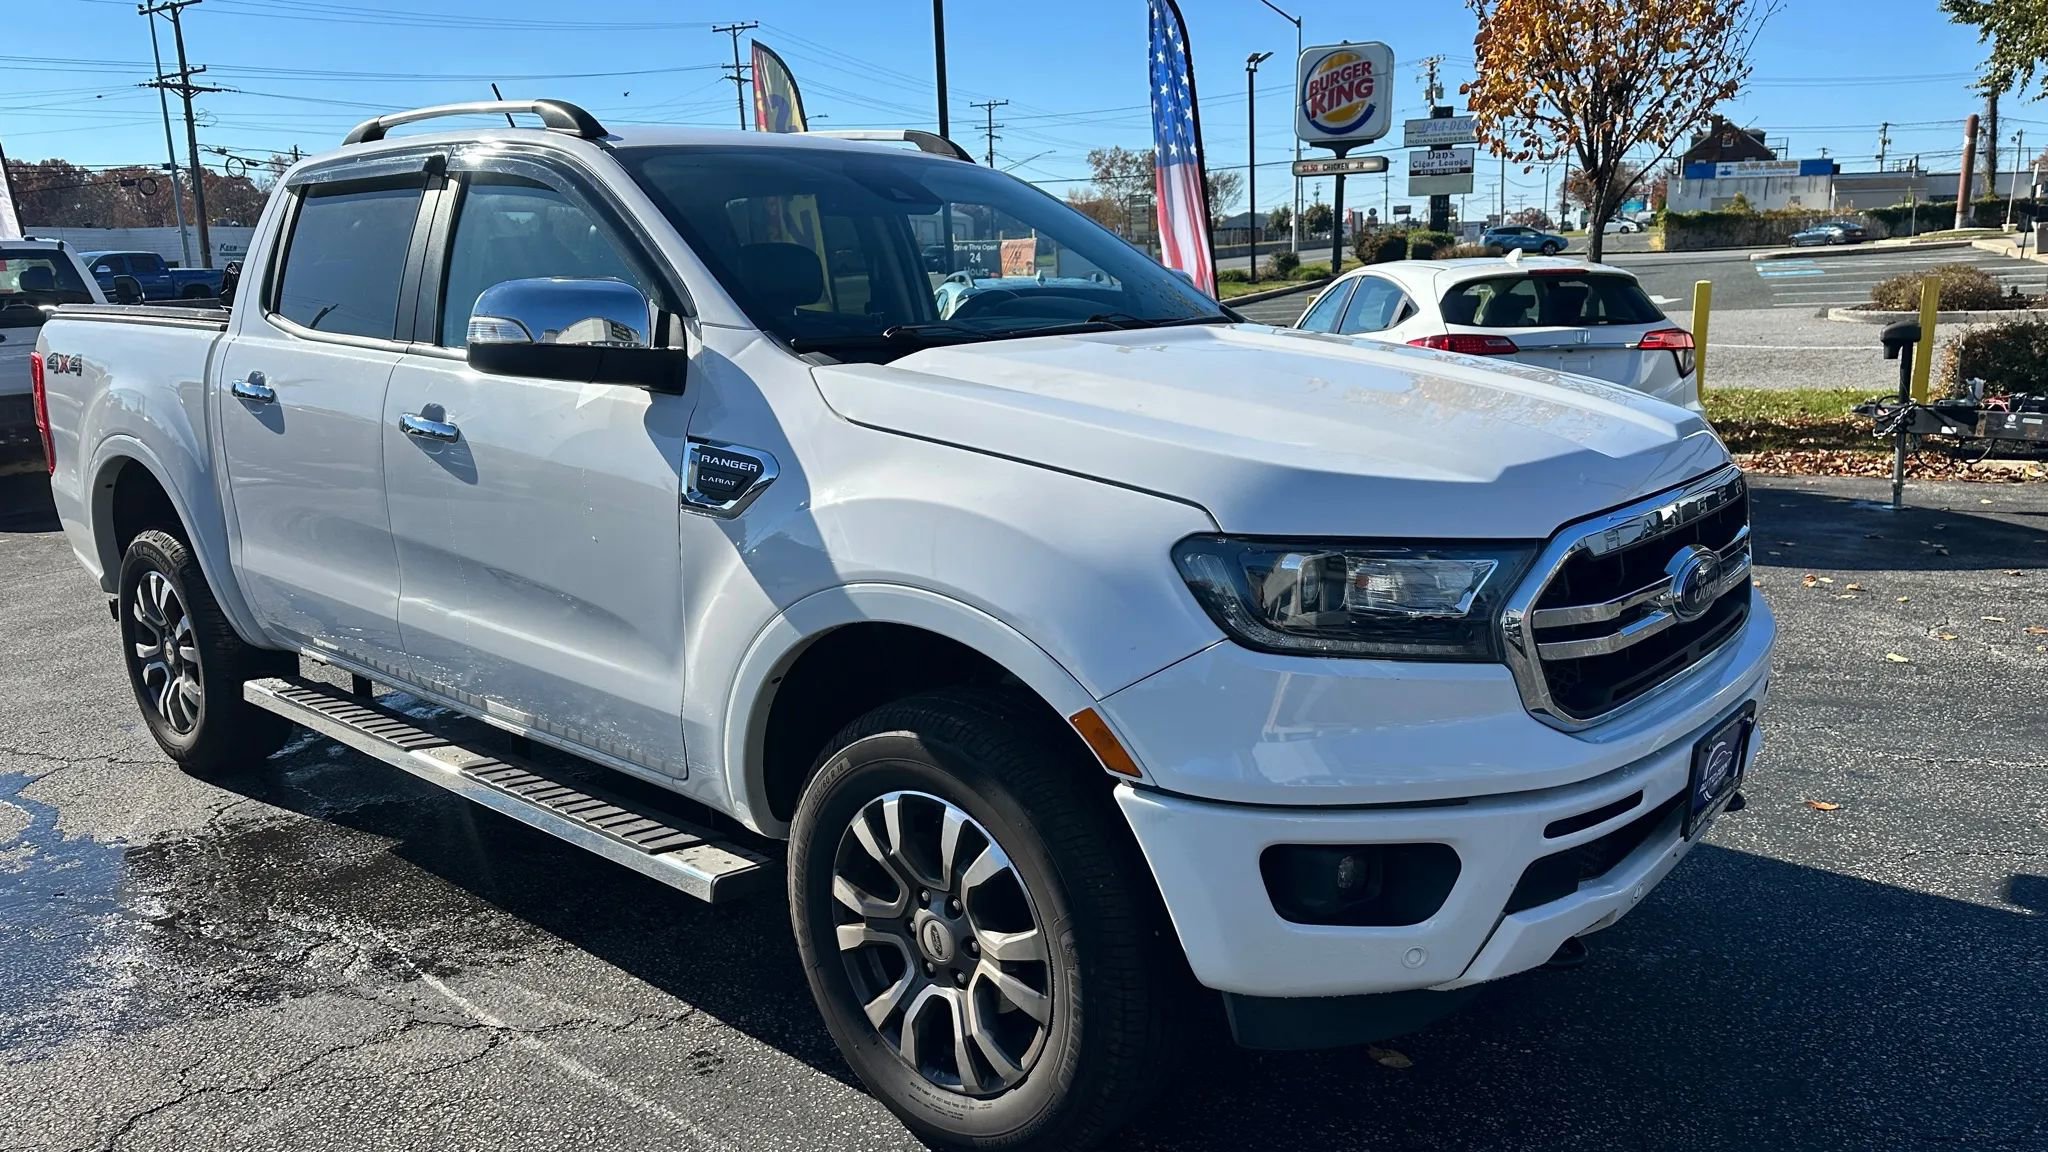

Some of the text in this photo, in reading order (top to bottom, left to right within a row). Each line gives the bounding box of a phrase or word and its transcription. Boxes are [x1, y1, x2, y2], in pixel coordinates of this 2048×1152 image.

[1309, 61, 1372, 98] BURGER
[1311, 78, 1374, 118] KING
[1322, 162, 1350, 171] CHICKEN
[1355, 161, 1365, 169] JR
[1412, 159, 1468, 168] Cigar Lounge
[969, 252, 981, 263] 24
[964, 266, 989, 276] Hours
[701, 454, 758, 473] RANGER
[701, 475, 736, 486] LARIAT
[1694, 573, 1718, 604] Ford
